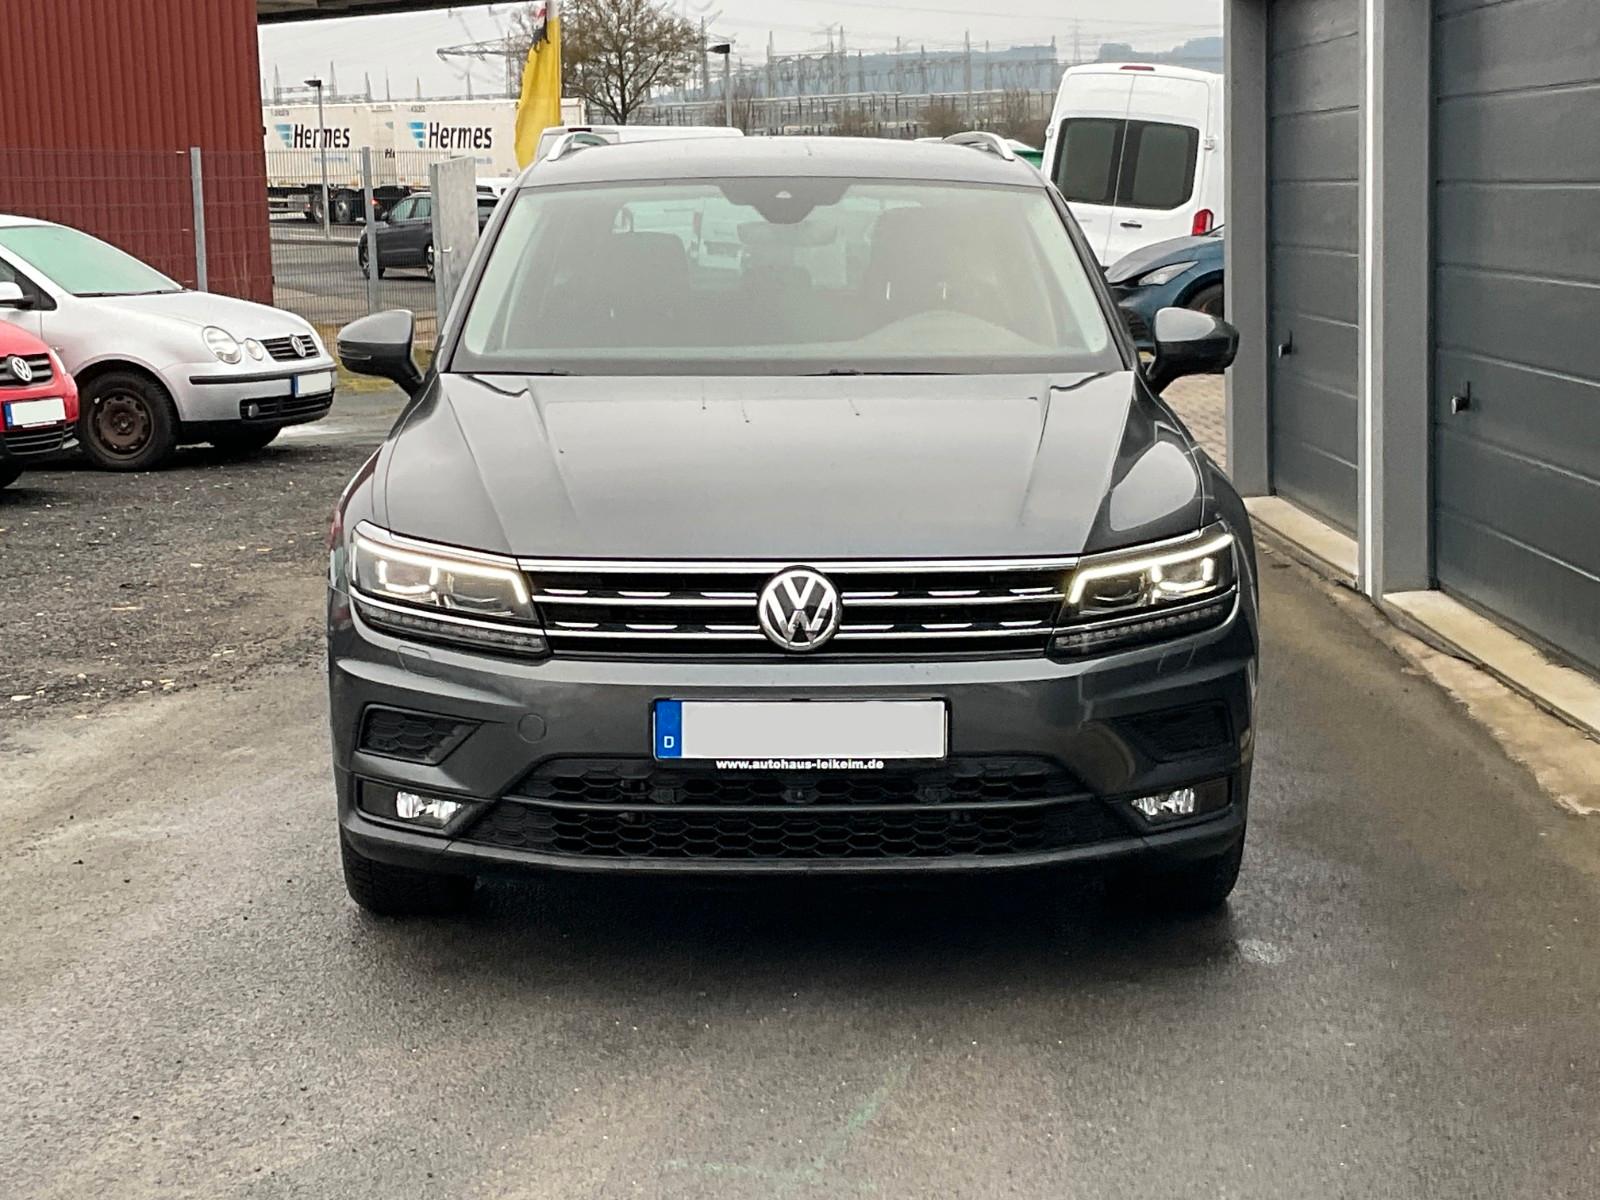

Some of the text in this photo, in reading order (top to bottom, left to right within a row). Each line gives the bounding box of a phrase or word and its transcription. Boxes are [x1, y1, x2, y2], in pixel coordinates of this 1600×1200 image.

[293, 123, 351, 149] Hermes
[428, 121, 493, 149] Hermes
[759, 569, 840, 650] VW
[663, 735, 675, 749] D
[715, 758, 885, 770] www.autohaus-leikeim.de
